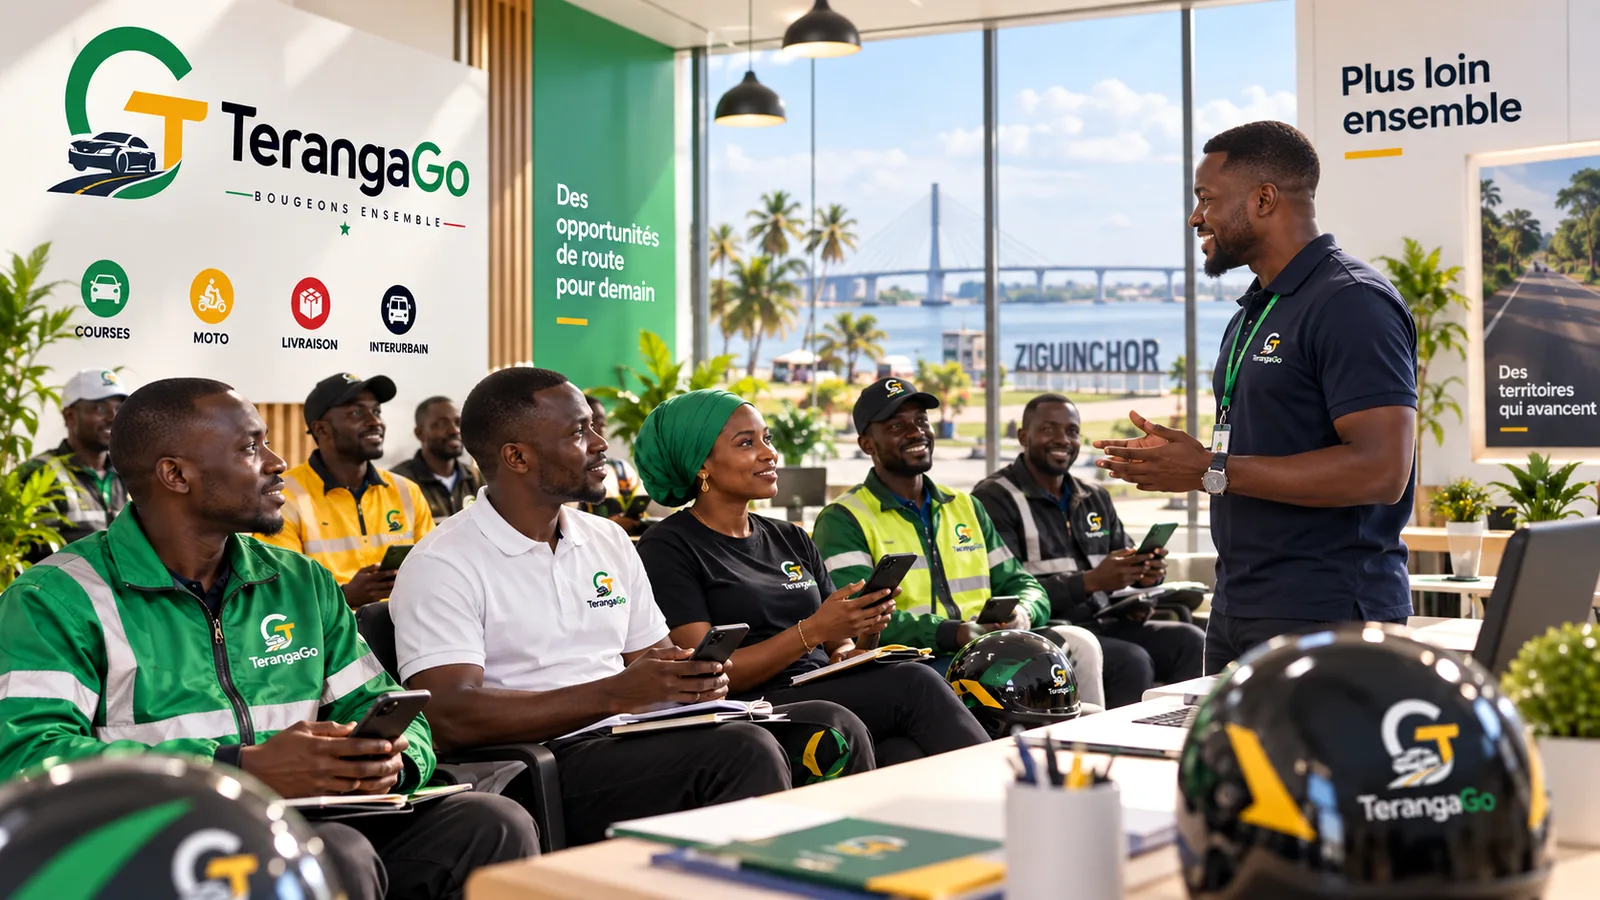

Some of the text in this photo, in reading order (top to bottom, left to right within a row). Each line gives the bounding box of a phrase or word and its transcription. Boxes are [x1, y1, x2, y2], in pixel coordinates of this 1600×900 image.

[1341, 53, 1490, 96] Plus loin
[1343, 92, 1522, 135] ensemble
[221, 101, 469, 197] TerangaGo
[557, 183, 588, 208] Des
[254, 191, 441, 228] BOUGEONS ENSEMBLE
[556, 218, 659, 245] opportunités
[556, 243, 624, 270] de route
[556, 277, 655, 302] pour demain
[75, 325, 130, 340] COURSES
[193, 331, 230, 345] MOTO
[282, 337, 338, 351] LIVRAISON
[369, 341, 429, 355] INTERURBAIN
[1014, 340, 1159, 372] ZIGUINCHOR
[1498, 364, 1528, 380] Des
[1498, 382, 1575, 399] territoires
[1498, 400, 1598, 419] qui avancent
[587, 595, 626, 609] TerangaGo
[249, 647, 318, 670] TerangaGo
[1356, 786, 1496, 823] TerangaGo
